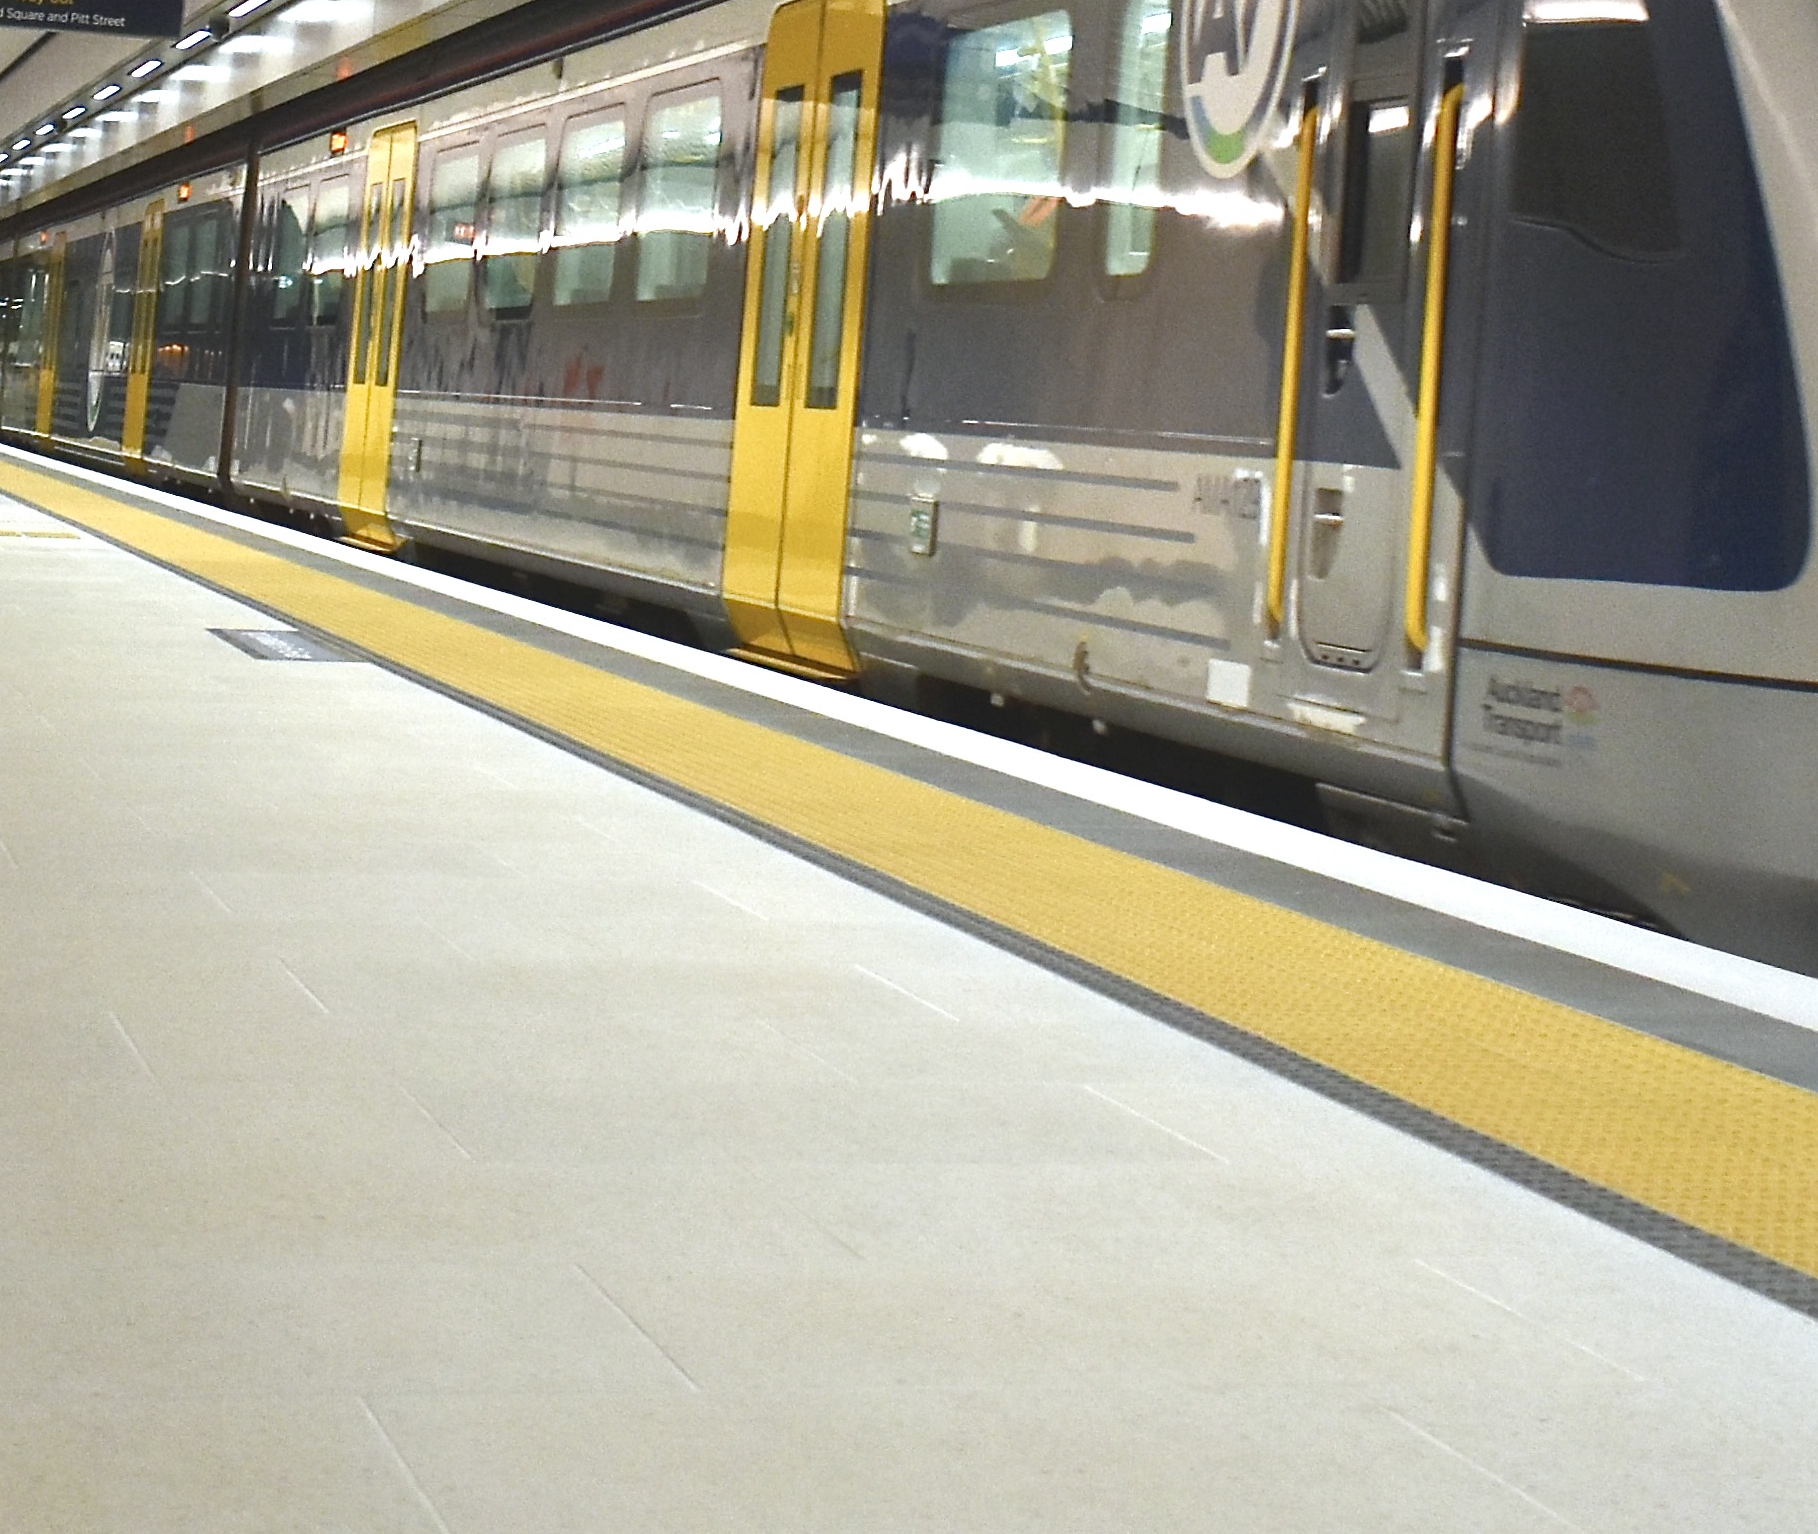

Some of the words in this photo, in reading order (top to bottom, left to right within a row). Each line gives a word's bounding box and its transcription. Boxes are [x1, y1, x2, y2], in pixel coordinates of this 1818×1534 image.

[6, 7, 45, 22] Square
[46, 11, 69, 23] and
[70, 12, 90, 25] Pitt
[92, 14, 126, 28] Street
